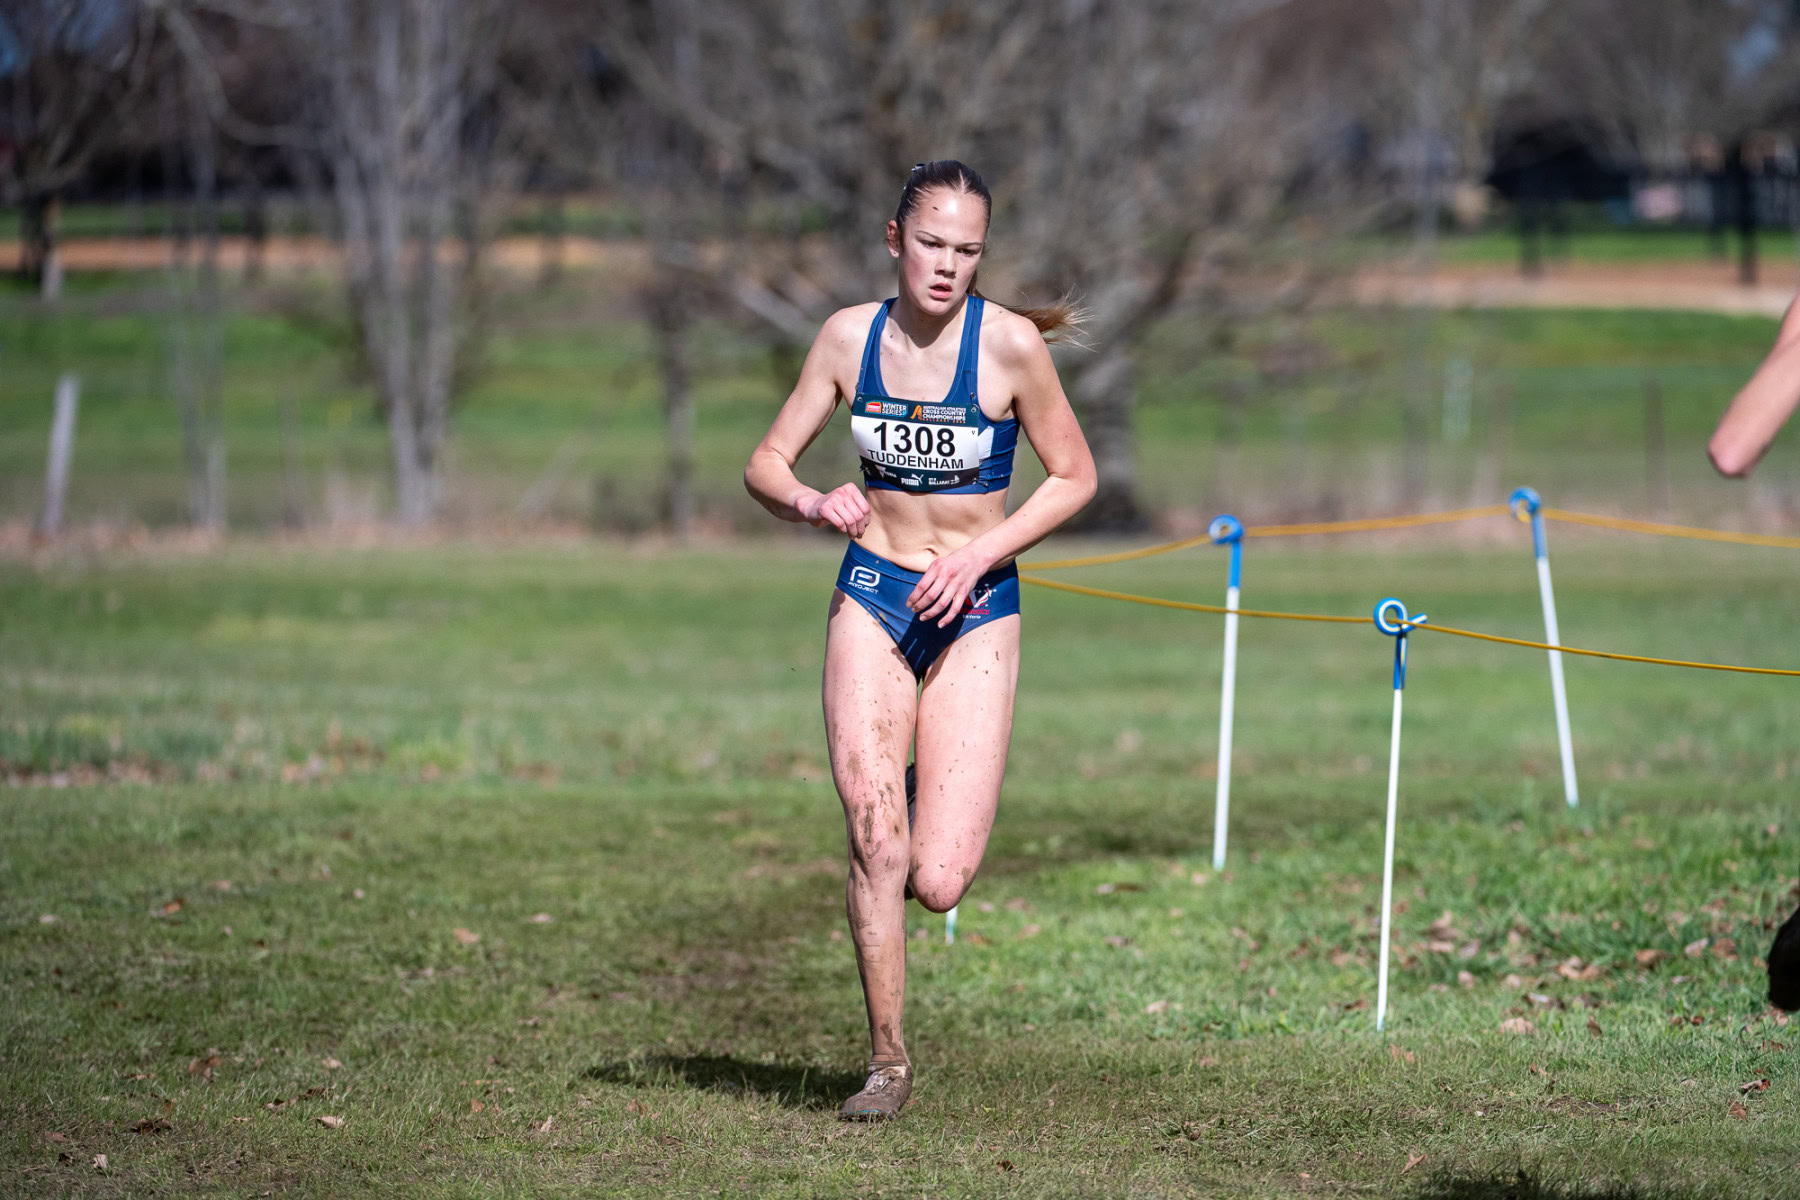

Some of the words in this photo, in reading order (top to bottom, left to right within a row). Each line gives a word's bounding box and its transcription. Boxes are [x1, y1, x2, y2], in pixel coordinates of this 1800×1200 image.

[882, 402, 907, 411] WINTER
[923, 413, 966, 421] CHAMPIONSHIPS
[874, 421, 956, 457] 1308
[867, 449, 964, 469] TUDDENHAM
[900, 477, 920, 486] PUMA
[848, 581, 879, 594] PROJECT
